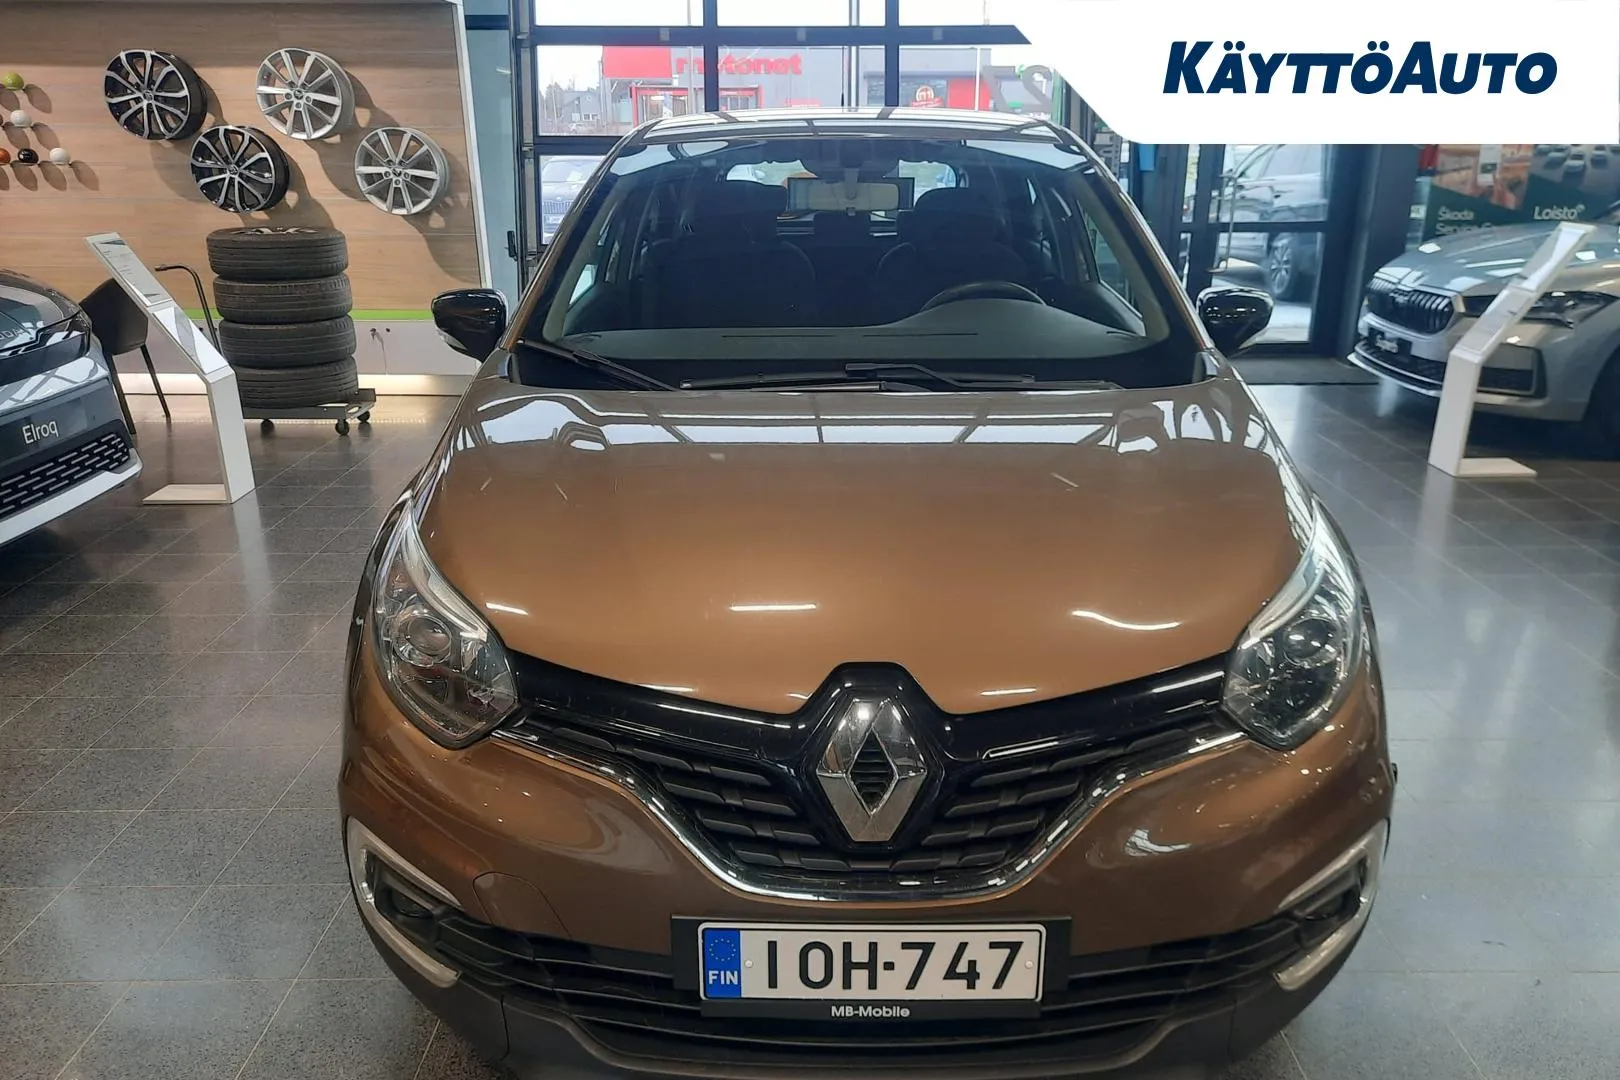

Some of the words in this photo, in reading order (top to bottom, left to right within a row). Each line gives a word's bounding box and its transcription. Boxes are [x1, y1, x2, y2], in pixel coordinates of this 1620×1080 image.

[675, 53, 803, 76] mtonet
[22, 421, 59, 444] Elroq
[708, 970, 739, 986] FIN
[767, 940, 1025, 991] IOH-747
[831, 1005, 910, 1017] MB-Mobile
